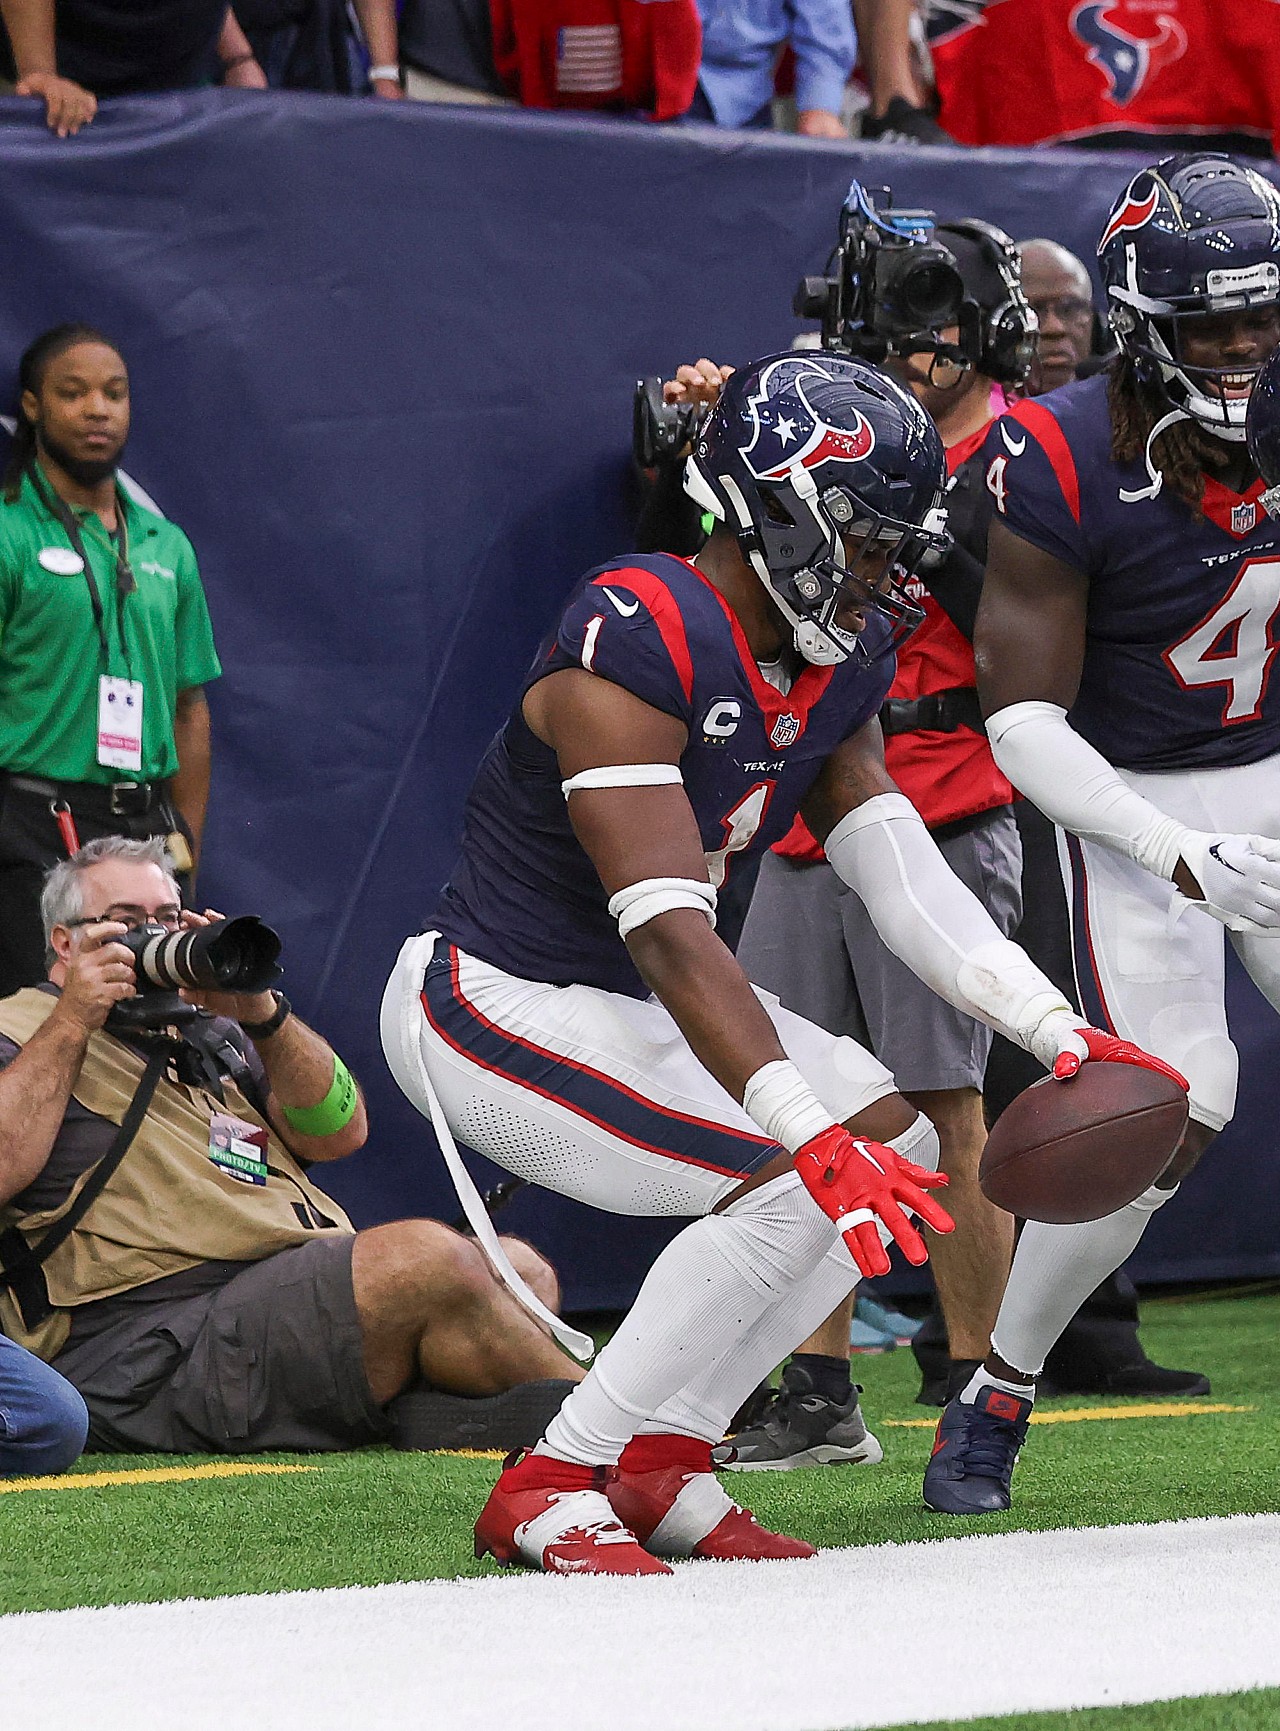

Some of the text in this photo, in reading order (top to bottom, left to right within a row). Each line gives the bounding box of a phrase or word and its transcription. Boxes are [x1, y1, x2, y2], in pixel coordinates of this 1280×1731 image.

[985, 453, 1009, 516] 4
[580, 613, 606, 673] 1
[702, 700, 742, 737] C
